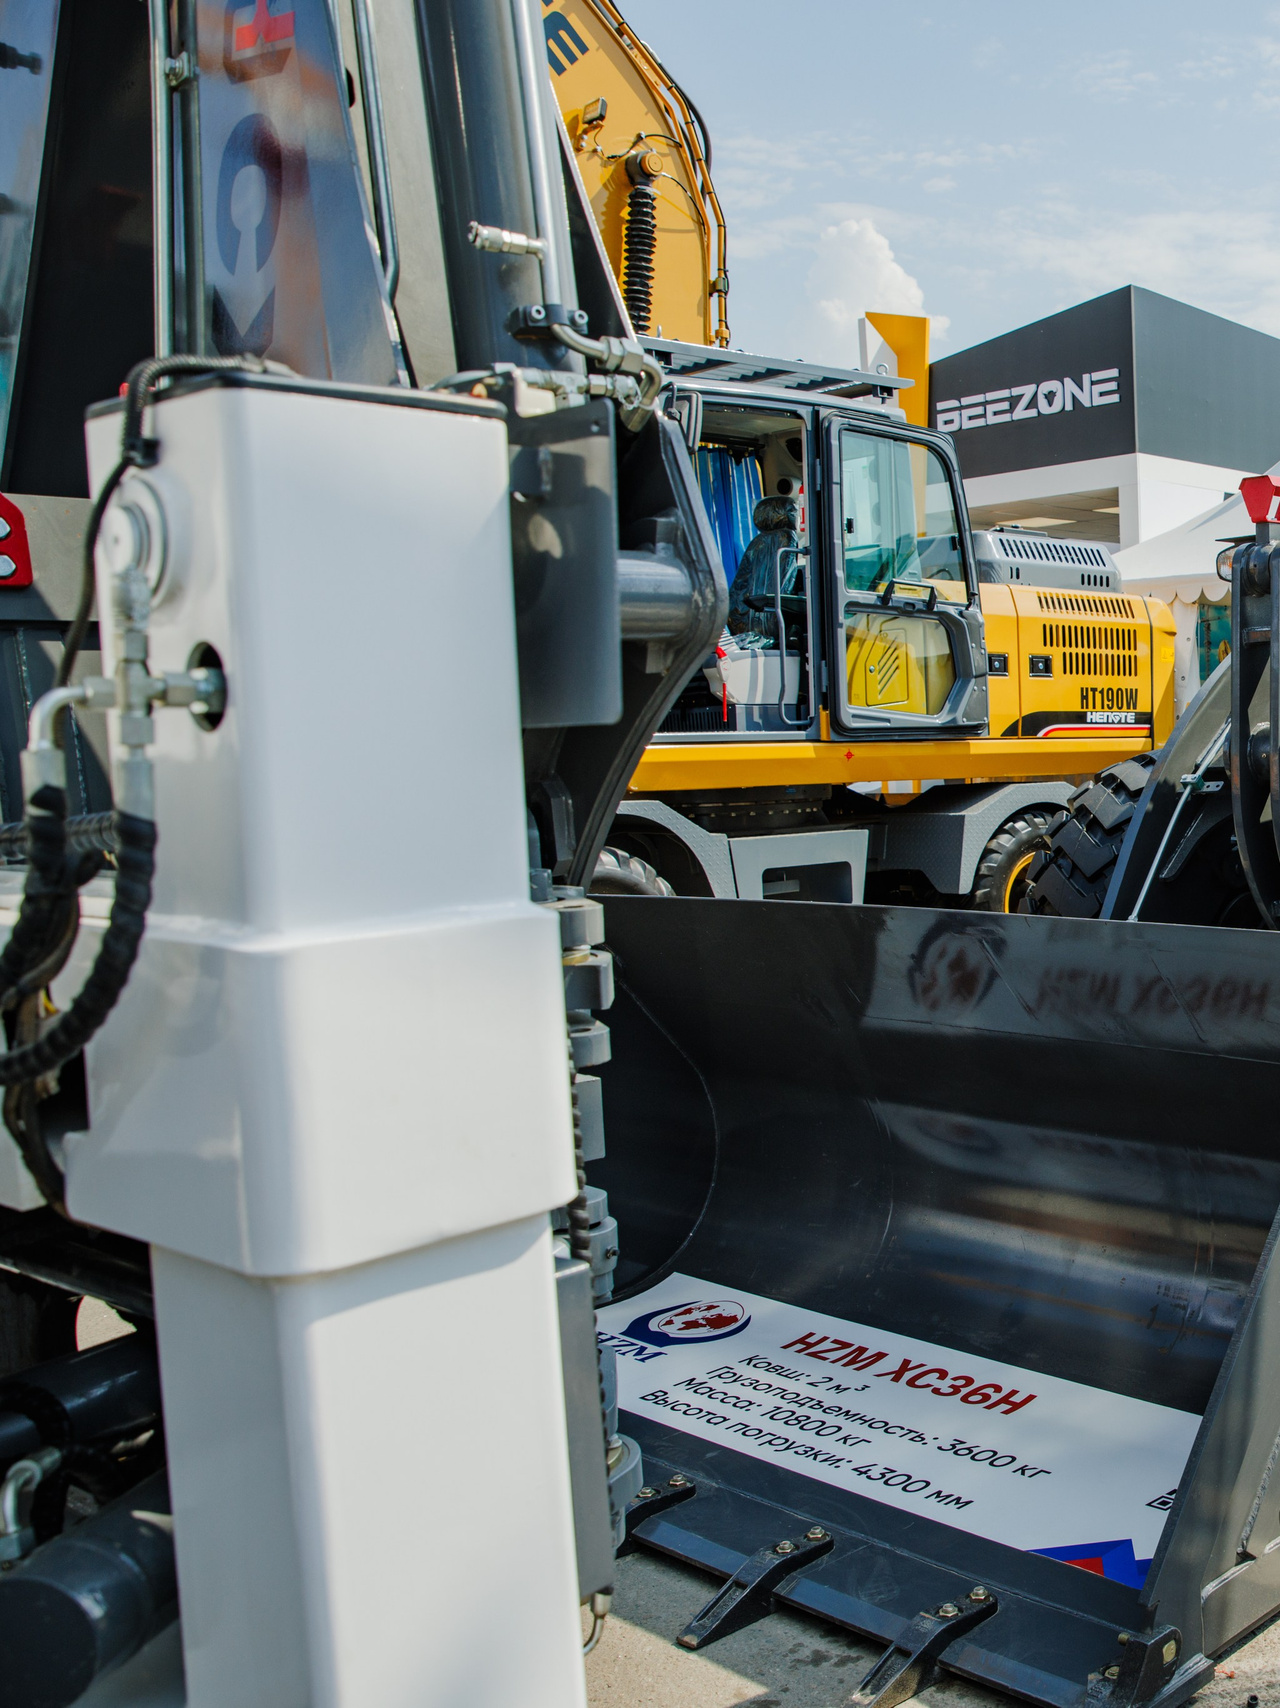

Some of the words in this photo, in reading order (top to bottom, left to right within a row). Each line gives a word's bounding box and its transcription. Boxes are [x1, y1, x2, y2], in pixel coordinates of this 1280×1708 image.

[936, 368, 1120, 434] BEEZONE
[1080, 687, 1138, 710] HT190W
[738, 1354, 812, 1382] Ковш:
[807, 1376, 834, 1388] 2
[780, 1332, 890, 1372] HZM
[873, 1358, 1038, 1416] XC36H
[673, 1377, 763, 1412] Масса:
[760, 1405, 843, 1437] 10800
[835, 1433, 872, 1447] кг
[706, 1365, 939, 1446] Грузоподъемность:
[936, 1438, 1018, 1468] 3600
[1012, 1464, 1052, 1479] кг
[638, 1389, 731, 1426] Высота
[724, 1421, 853, 1469] погрузки:
[850, 1463, 932, 1494] 4300
[924, 1489, 974, 1510] мм
